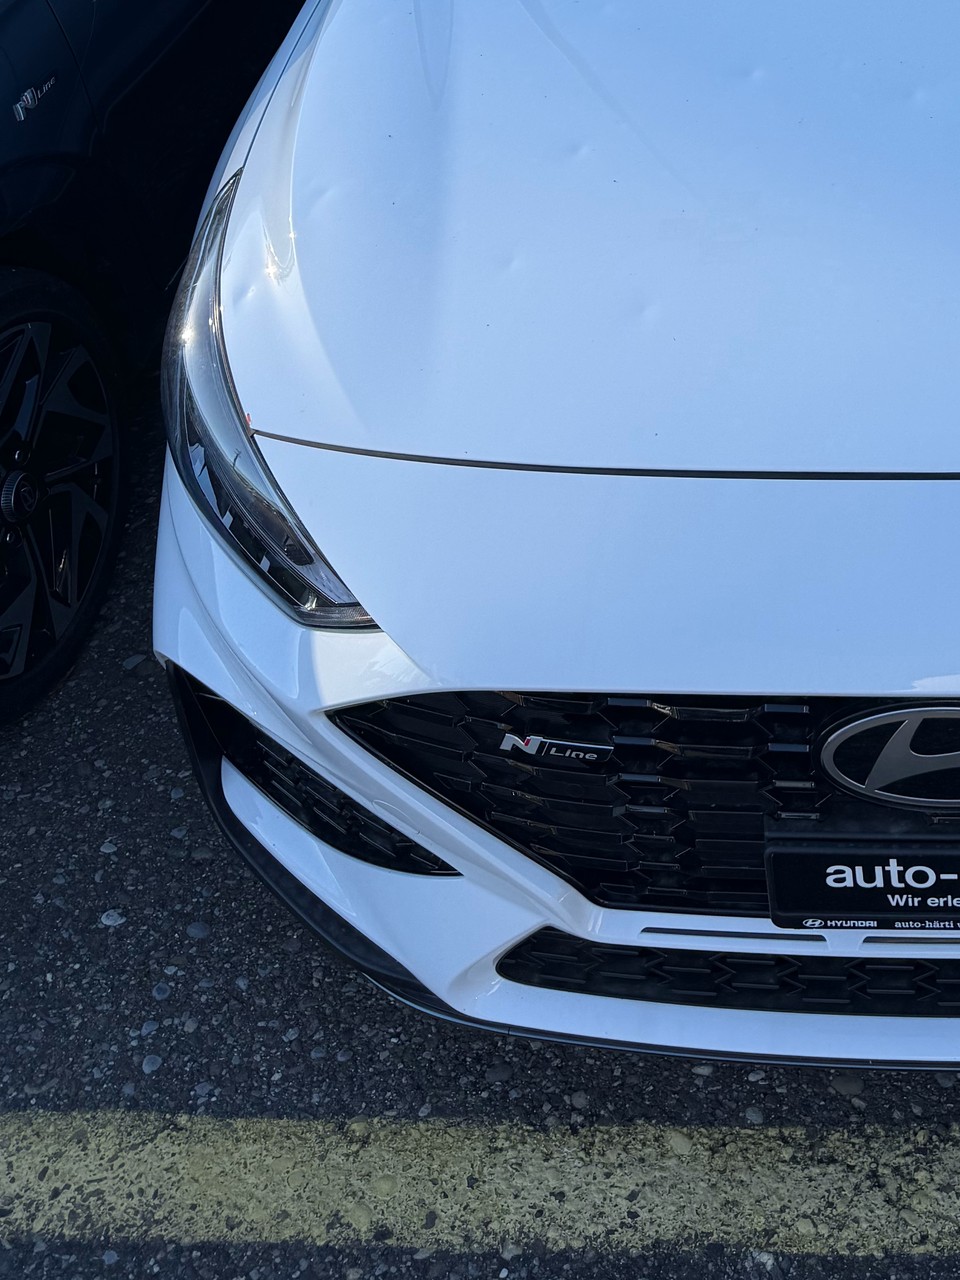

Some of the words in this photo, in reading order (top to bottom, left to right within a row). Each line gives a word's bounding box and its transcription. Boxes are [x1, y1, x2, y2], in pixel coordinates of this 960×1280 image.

[549, 747, 598, 760] Line
[887, 894, 922, 908] Wir
[827, 919, 877, 928] HYUNDAI
[894, 919, 955, 930] auto-härti
